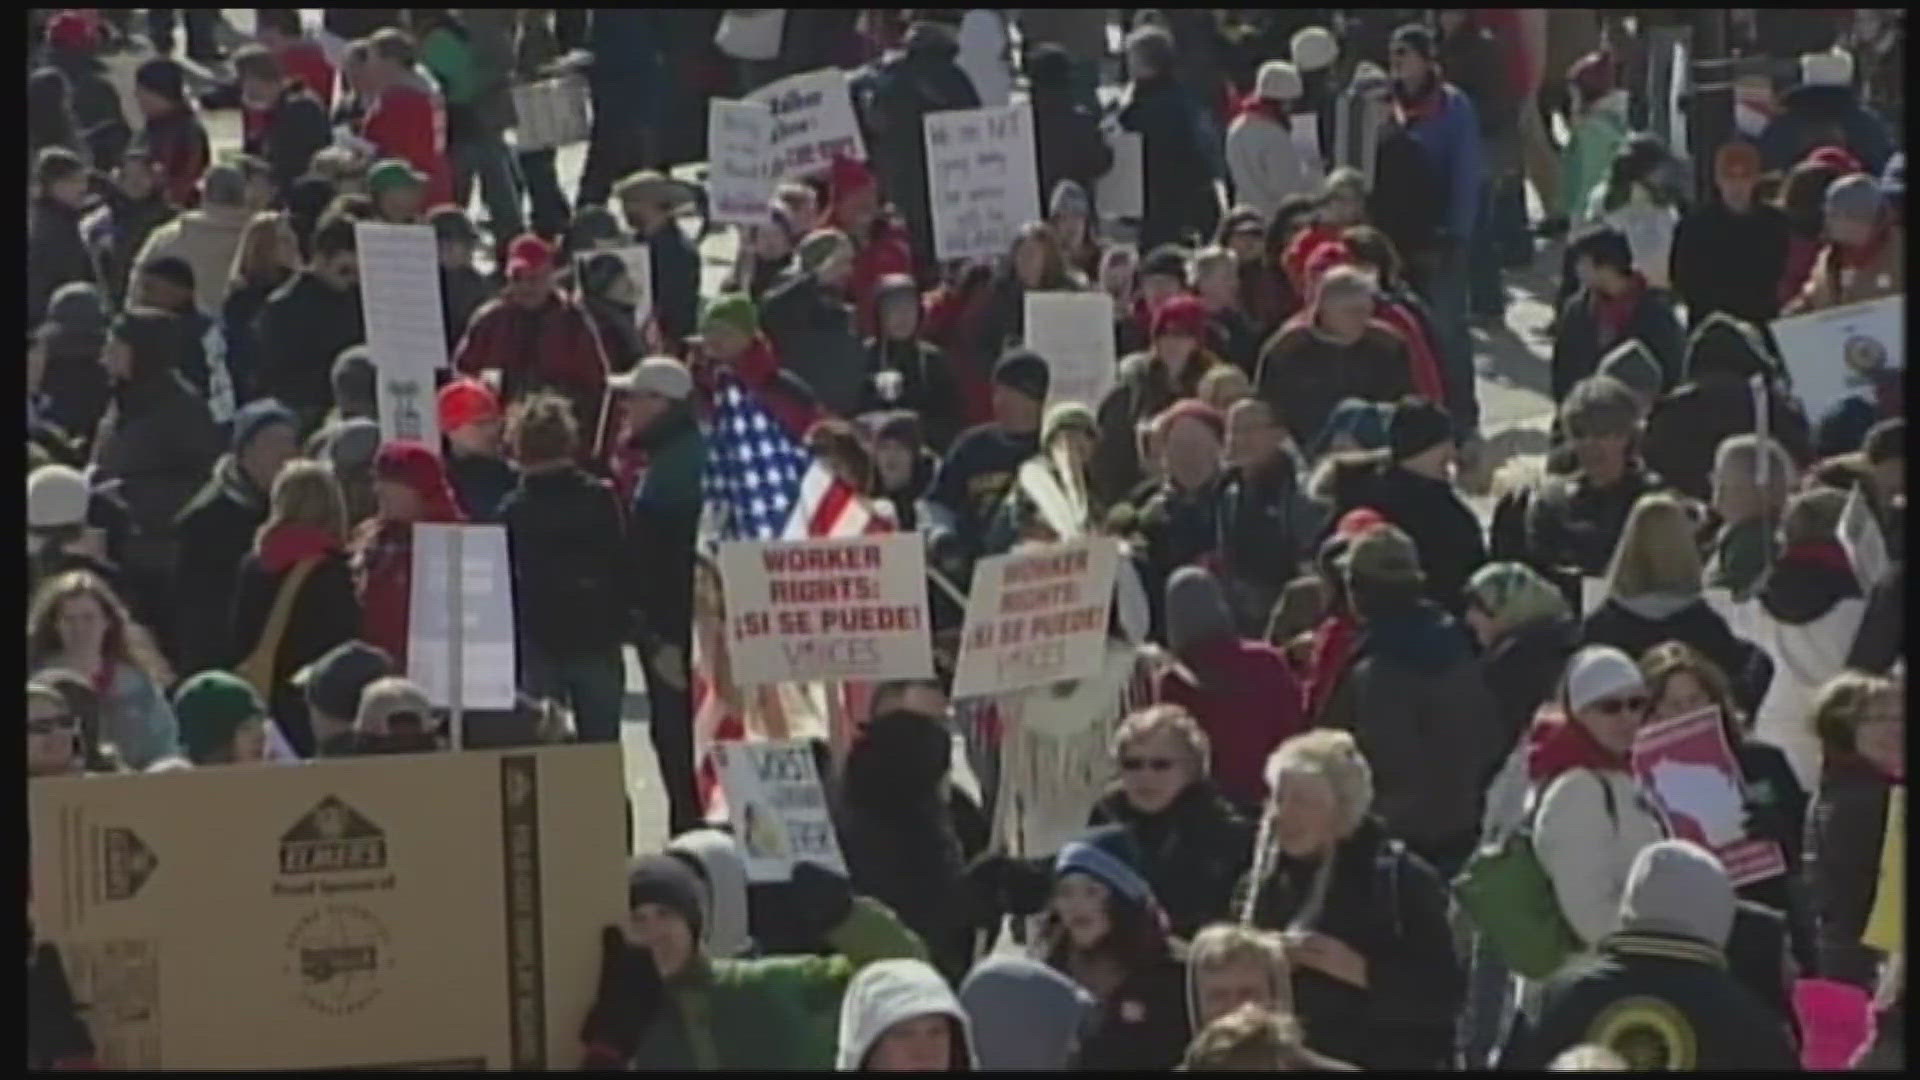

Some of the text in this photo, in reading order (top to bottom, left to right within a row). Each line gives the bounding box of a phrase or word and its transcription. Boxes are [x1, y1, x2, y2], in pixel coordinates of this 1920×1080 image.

[763, 546, 881, 573] WORKER
[1003, 551, 1089, 585] WORKER
[769, 576, 880, 604] RIGHTS:
[778, 609, 811, 634] SE
[821, 605, 921, 634] PUEDE!
[1000, 616, 1024, 645] SE
